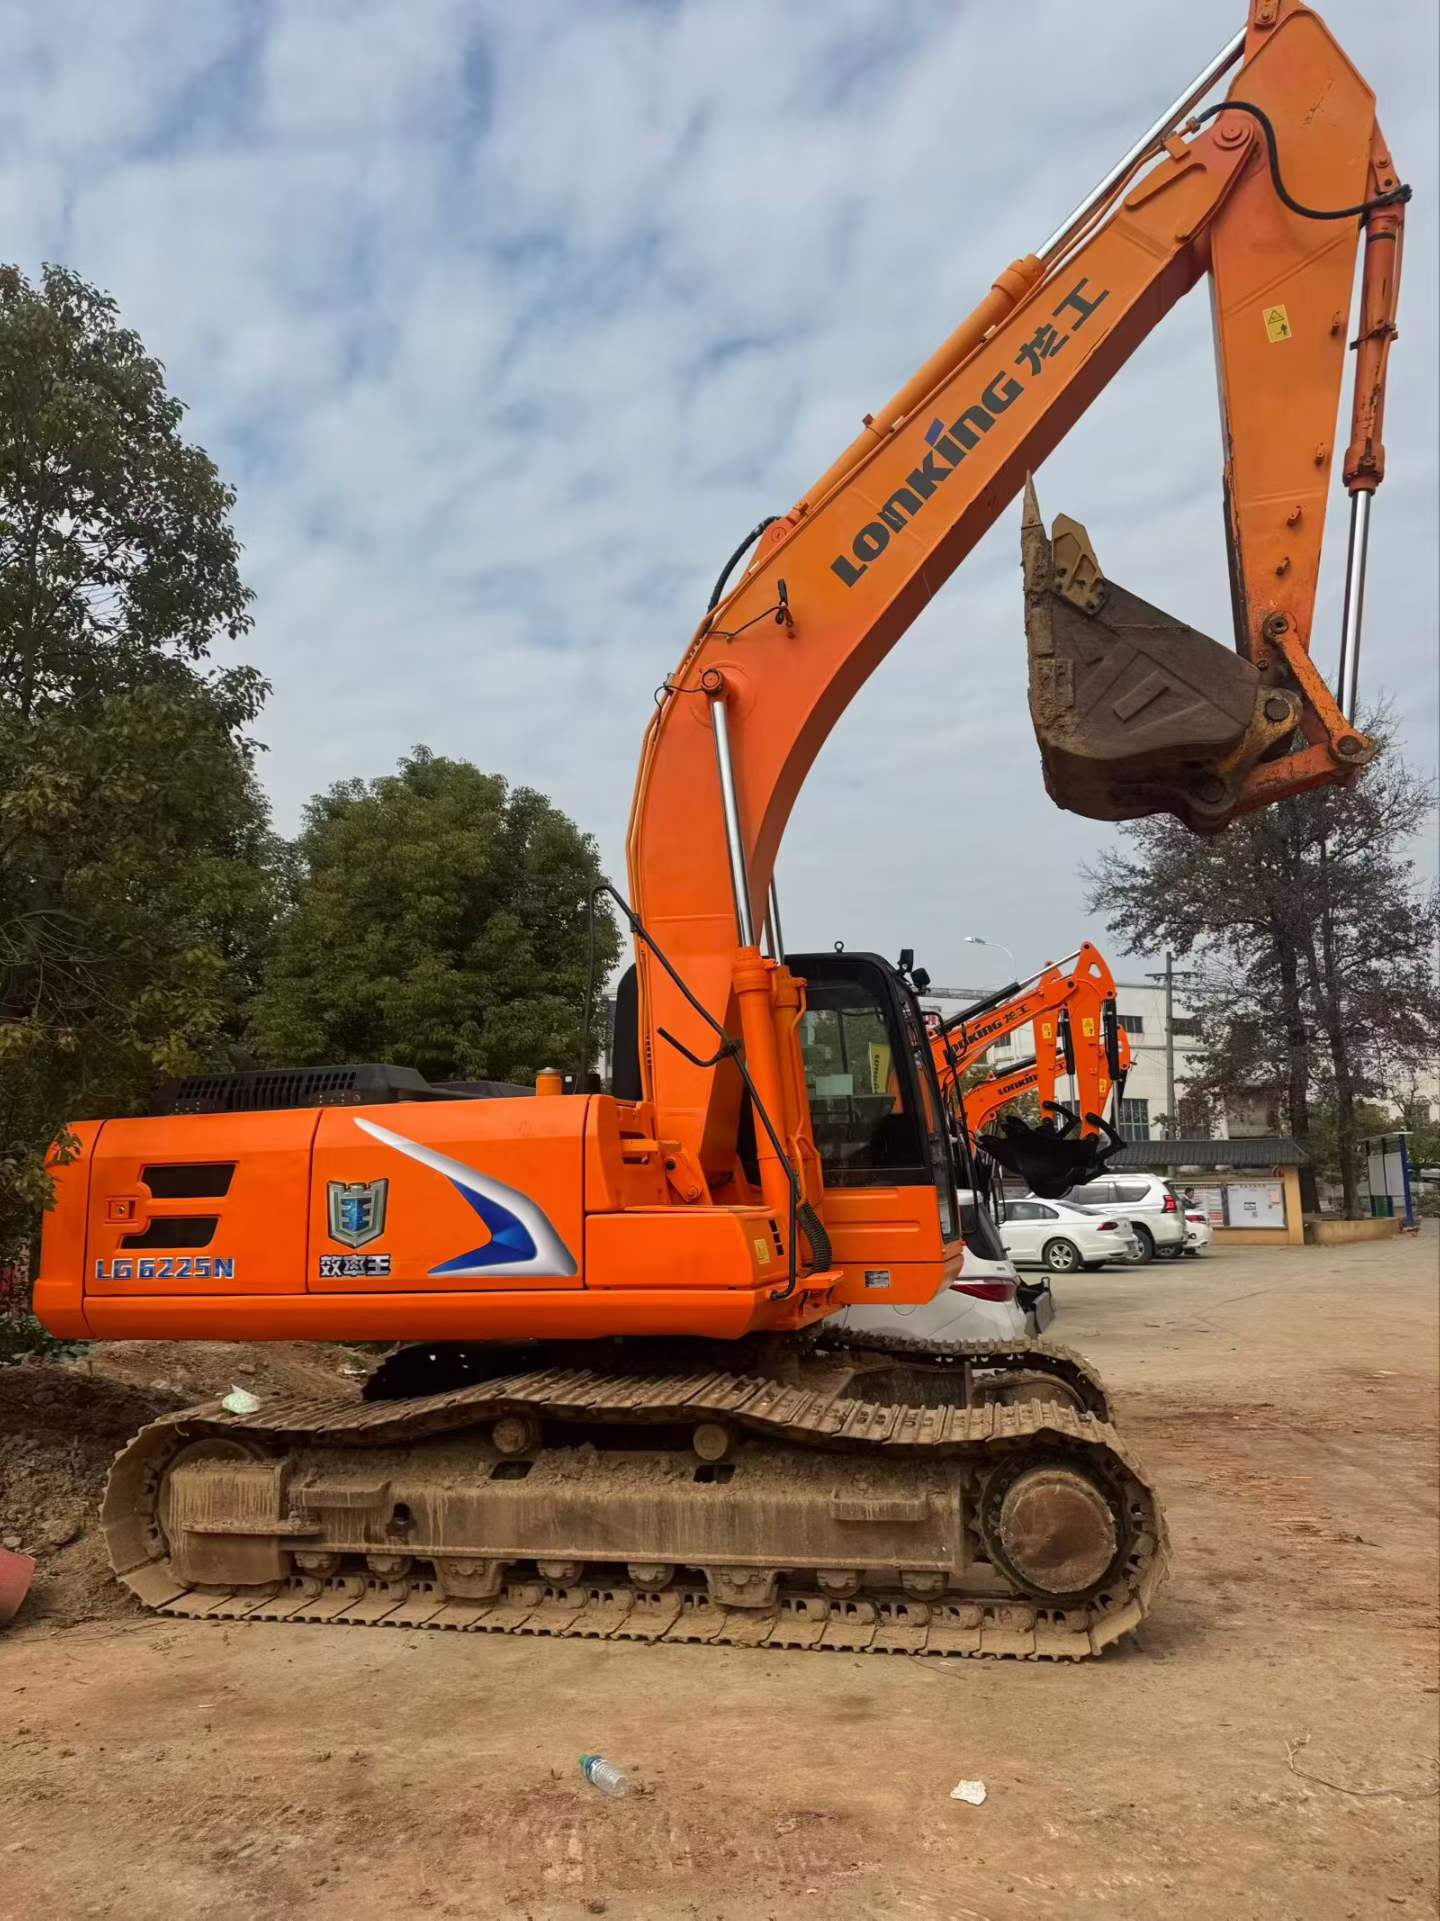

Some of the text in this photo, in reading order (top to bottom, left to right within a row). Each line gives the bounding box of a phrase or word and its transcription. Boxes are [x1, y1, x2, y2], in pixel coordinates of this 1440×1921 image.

[830, 277, 1111, 589] LONKING 龙工
[997, 1073, 1040, 1096] LONKIN
[320, 1253, 391, 1277] 效率王
